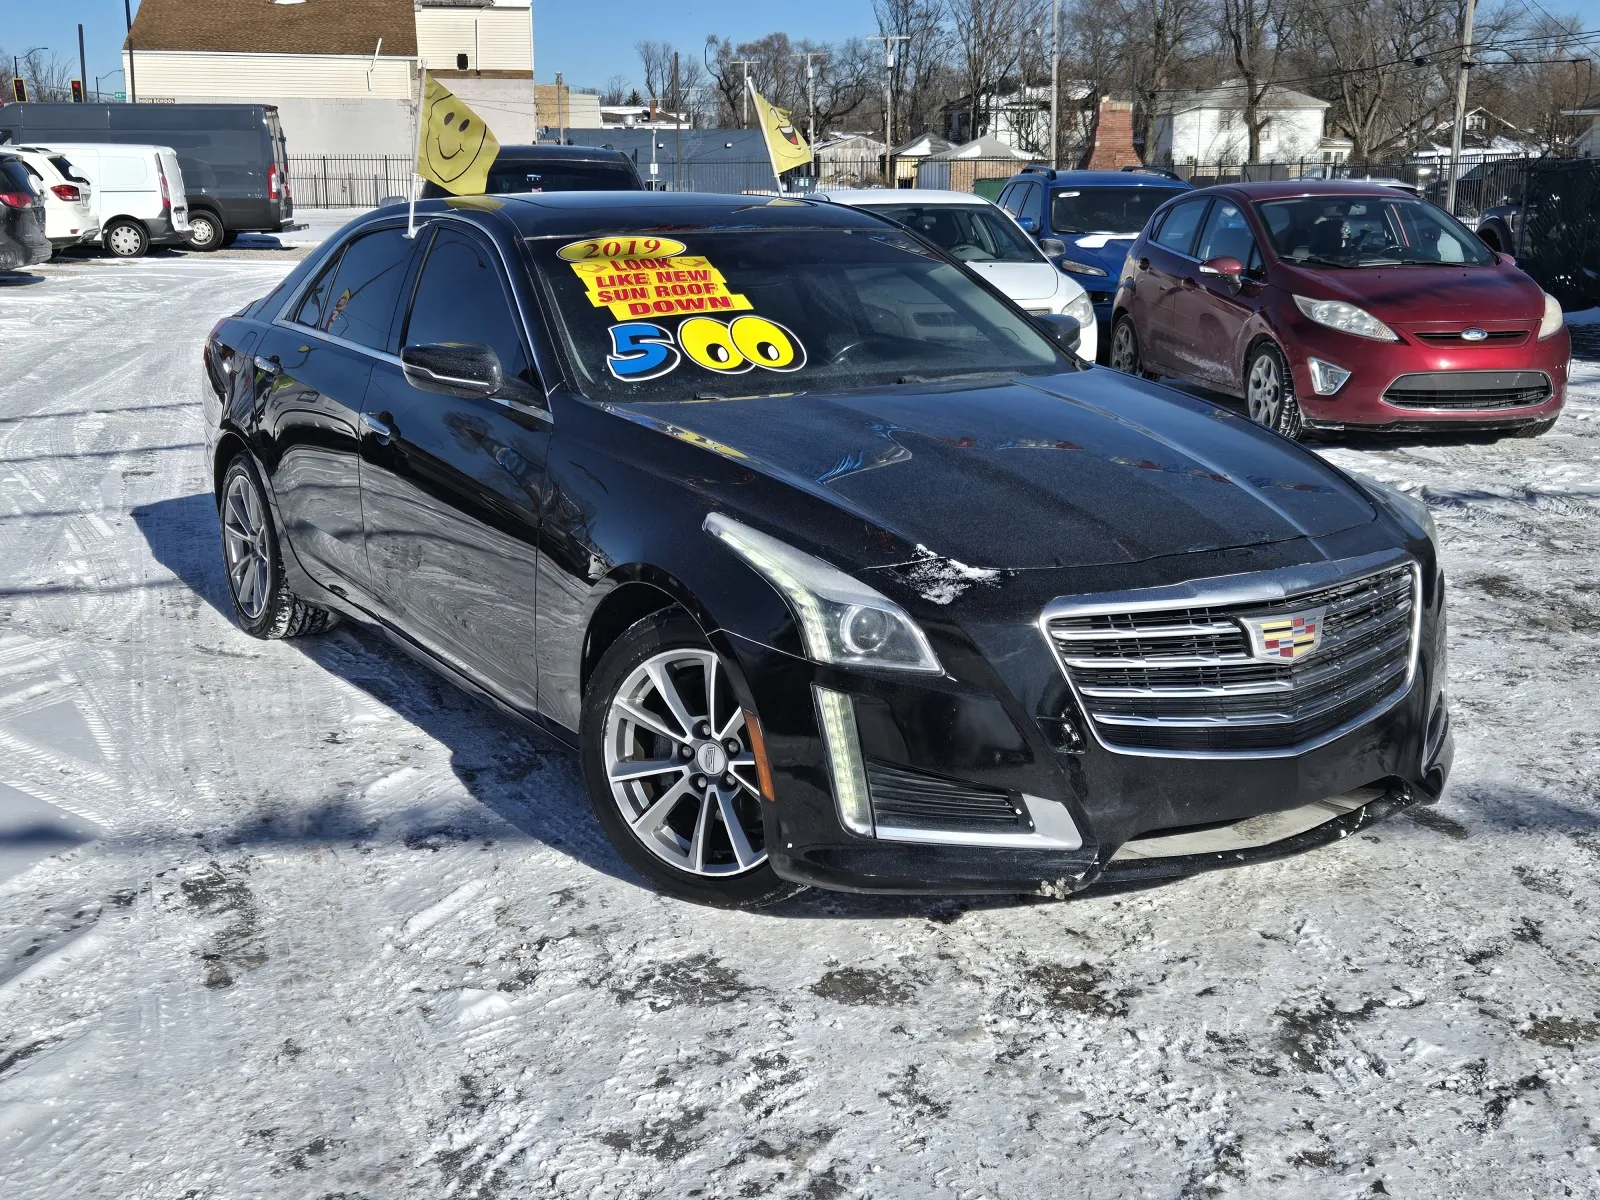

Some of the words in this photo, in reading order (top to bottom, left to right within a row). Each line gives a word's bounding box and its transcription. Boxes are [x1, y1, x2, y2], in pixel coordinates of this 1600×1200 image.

[583, 239, 661, 259] 2019
[609, 257, 675, 272] LOOK
[595, 272, 650, 289] LIKE
[655, 269, 712, 284] NEW
[597, 287, 650, 303] SUN
[655, 282, 718, 298] ROOF
[627, 296, 735, 316] DOWN
[607, 315, 807, 382] 500
